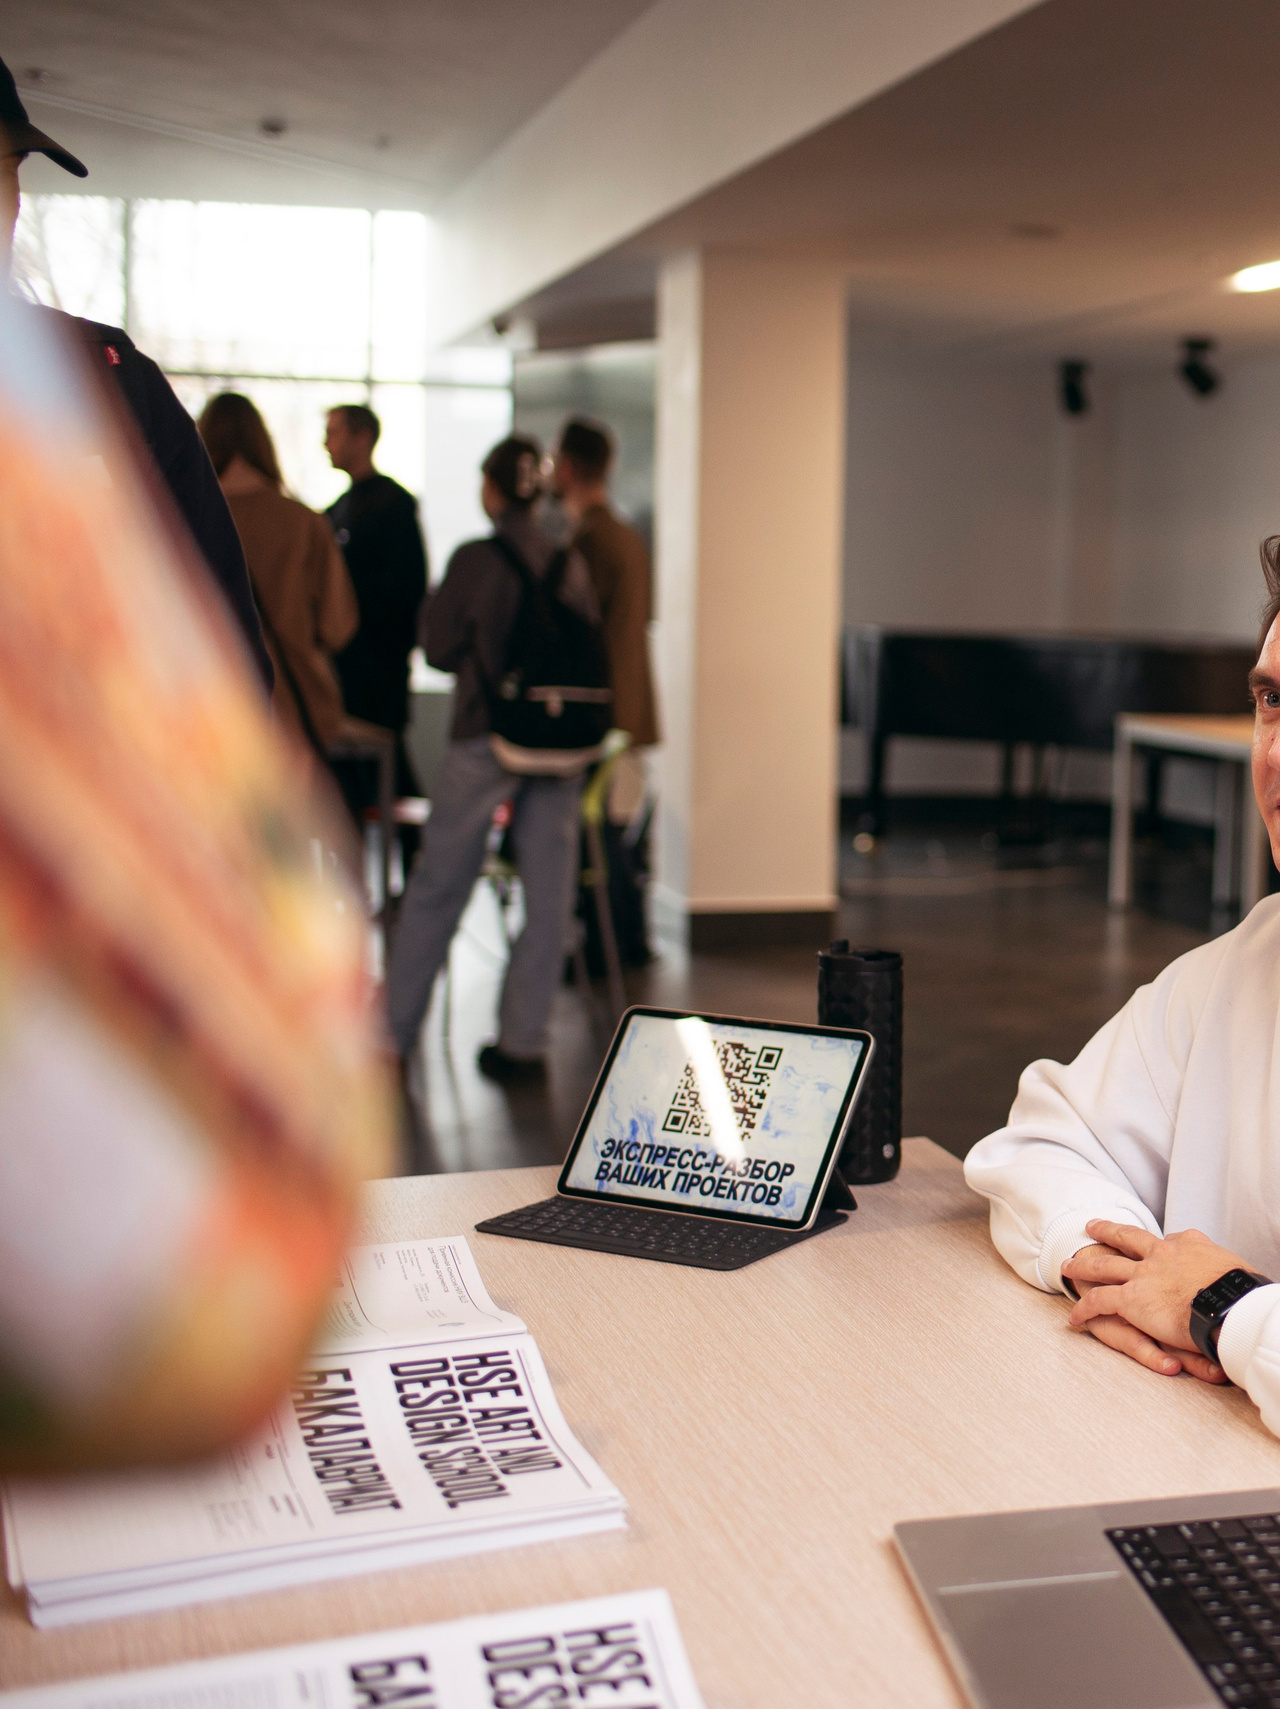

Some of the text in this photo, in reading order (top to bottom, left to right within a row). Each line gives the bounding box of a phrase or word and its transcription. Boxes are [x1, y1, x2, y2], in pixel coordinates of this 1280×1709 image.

[595, 1161, 783, 1206] ВАШИХ ПРОЕКТОВ
[600, 1138, 795, 1183] ЭКСПРЕСС-РАЗБОР
[290, 1367, 402, 1515] БАКАЛАВРИАТ
[389, 1358, 511, 1509] DESIGN SCHOOL
[452, 1351, 562, 1476] HSE ART AND
[562, 1622, 653, 1699] HSE
